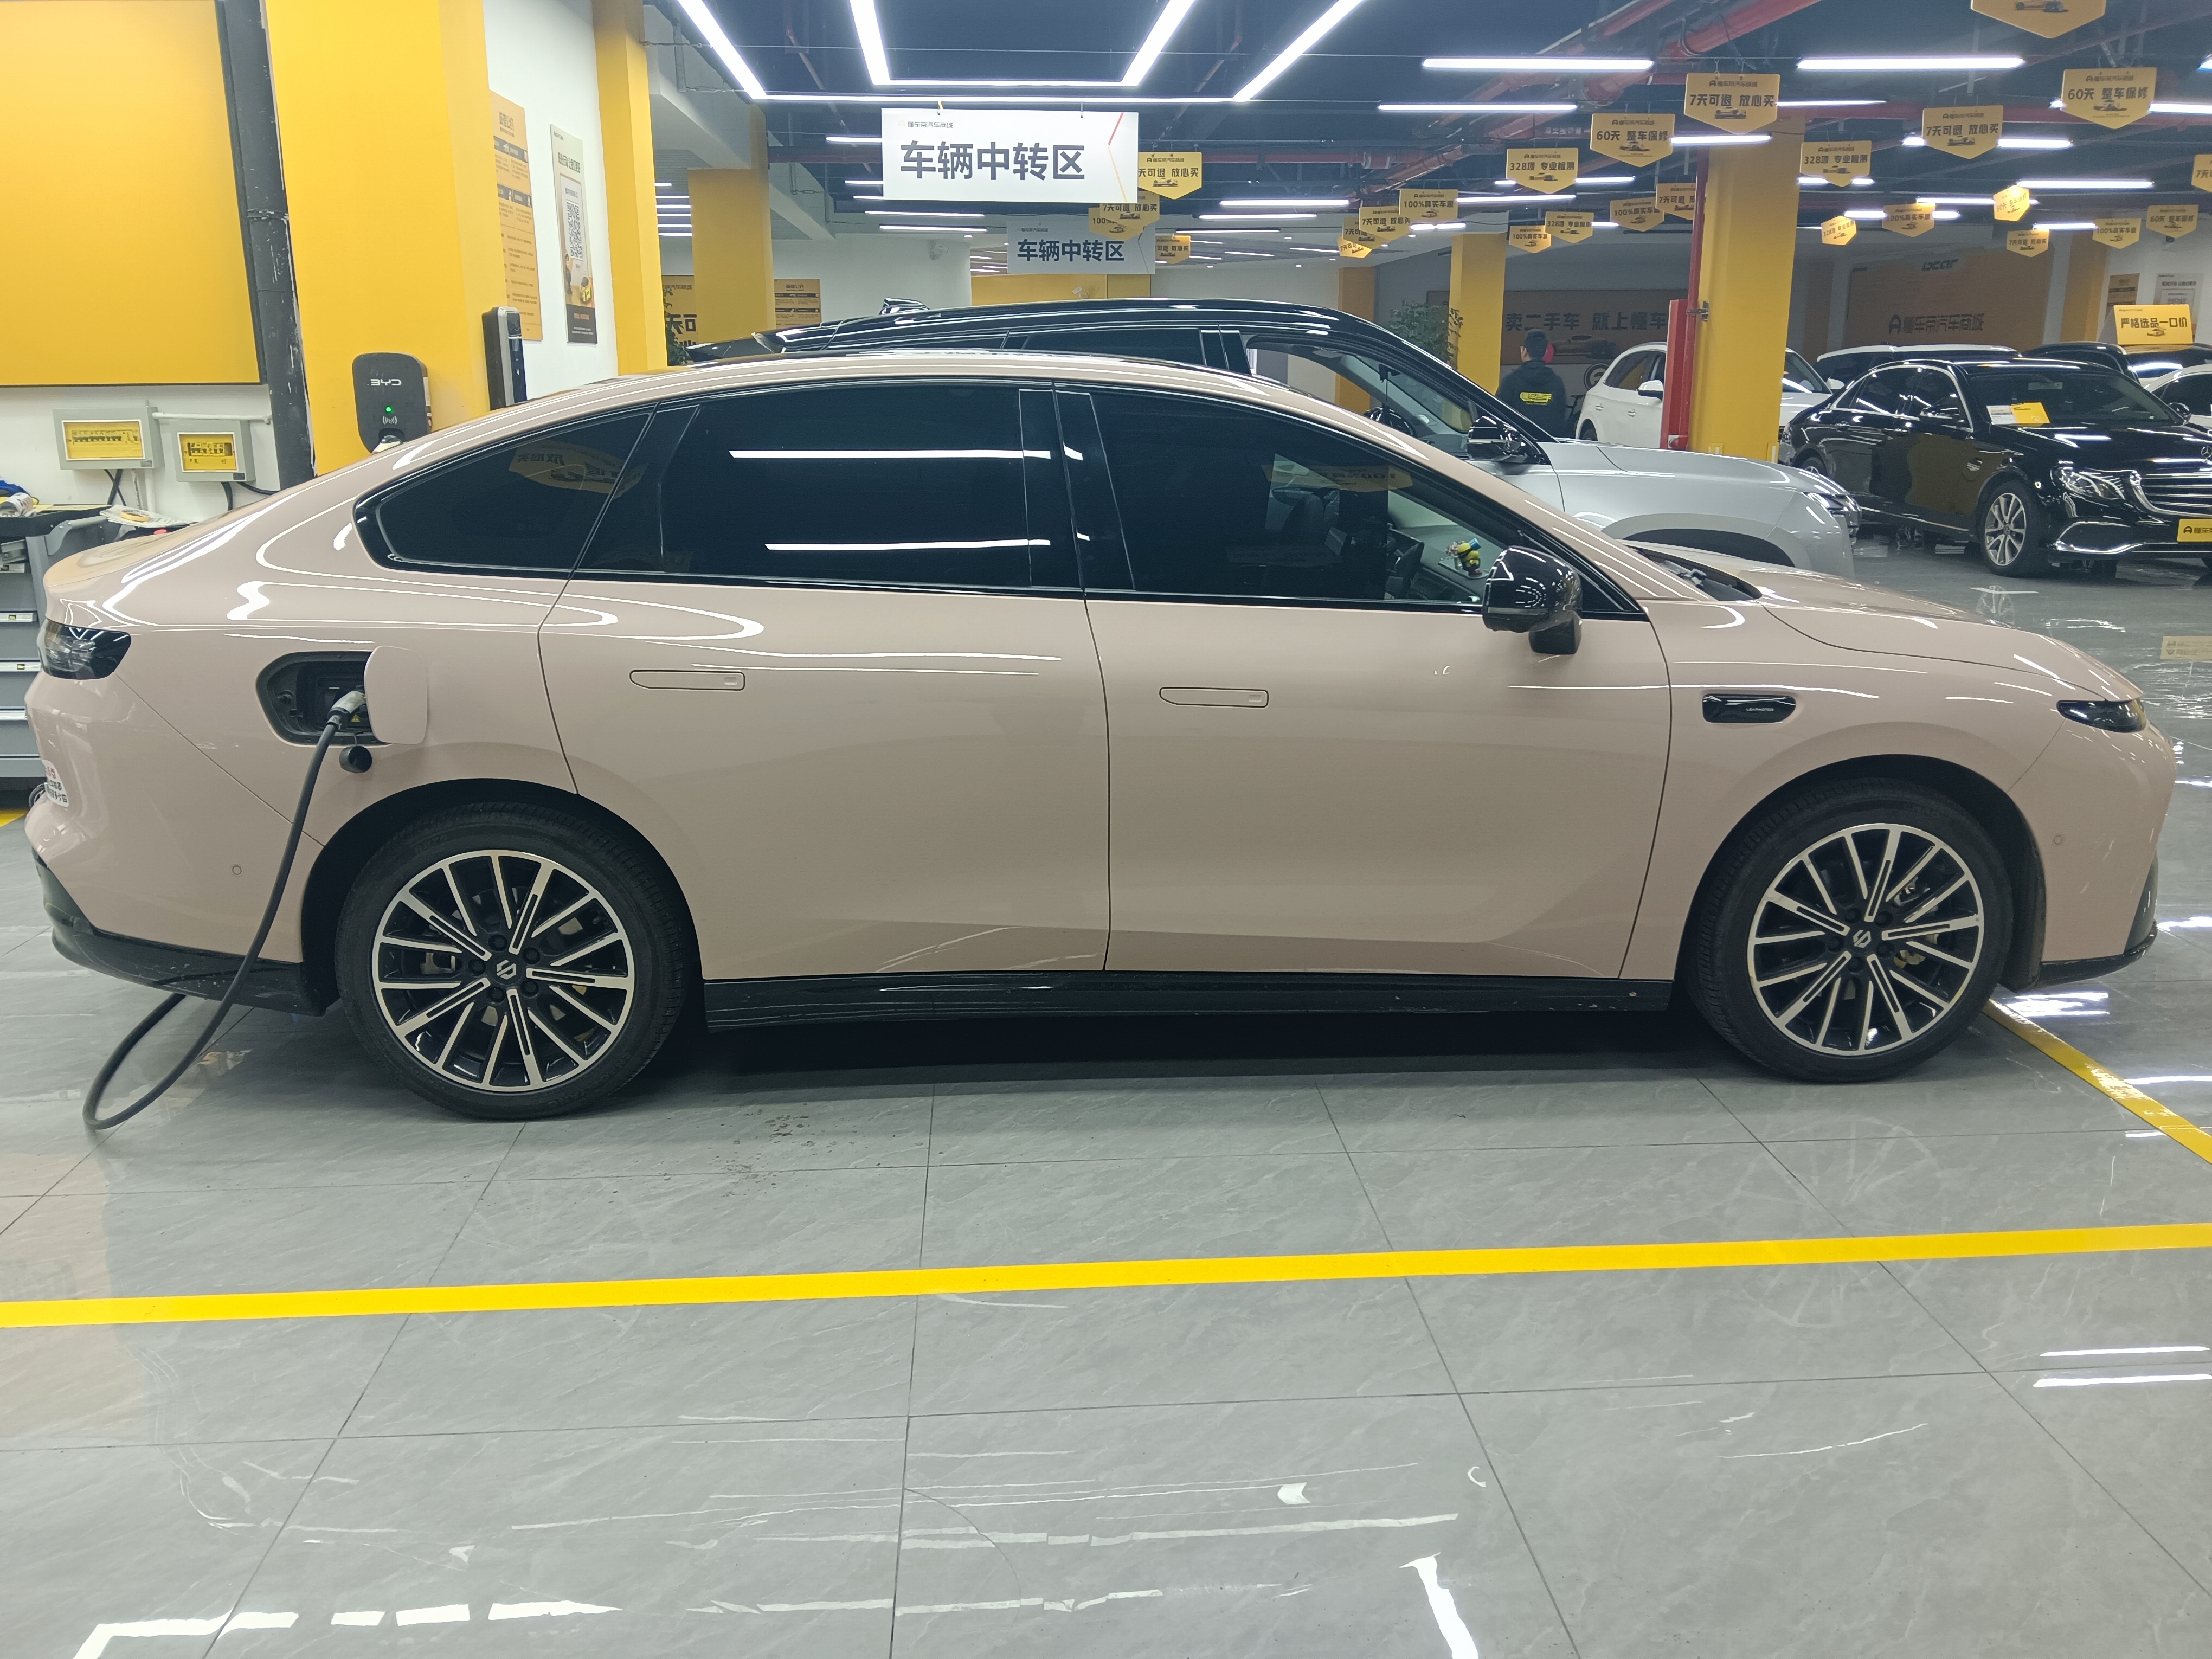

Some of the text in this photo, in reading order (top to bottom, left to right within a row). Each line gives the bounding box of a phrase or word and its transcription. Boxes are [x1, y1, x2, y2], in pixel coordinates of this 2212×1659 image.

[2068, 87, 2149, 100] 60天 整车保修
[1690, 94, 1774, 107] 7天可退 放心买
[1926, 123, 1999, 136] 7天可退 放心买
[1596, 131, 1620, 141] 60天
[1626, 131, 1668, 141] 整车保修
[901, 140, 1084, 181] 车辆中转区
[1804, 155, 1868, 164] 328项 专业检测
[1510, 162, 1574, 171] 328项 专业检测
[1172, 168, 1199, 177] 放心买
[1659, 196, 1685, 204] 7天可退
[1103, 204, 1158, 212] 7天可退 放心买
[1362, 218, 1386, 226] 7天可退
[1823, 226, 1836, 237] 328项
[1018, 239, 1124, 262] 车辆中转区
[1506, 313, 1580, 331] 卖二手车
[2121, 317, 2188, 328] 严格选品一口价
